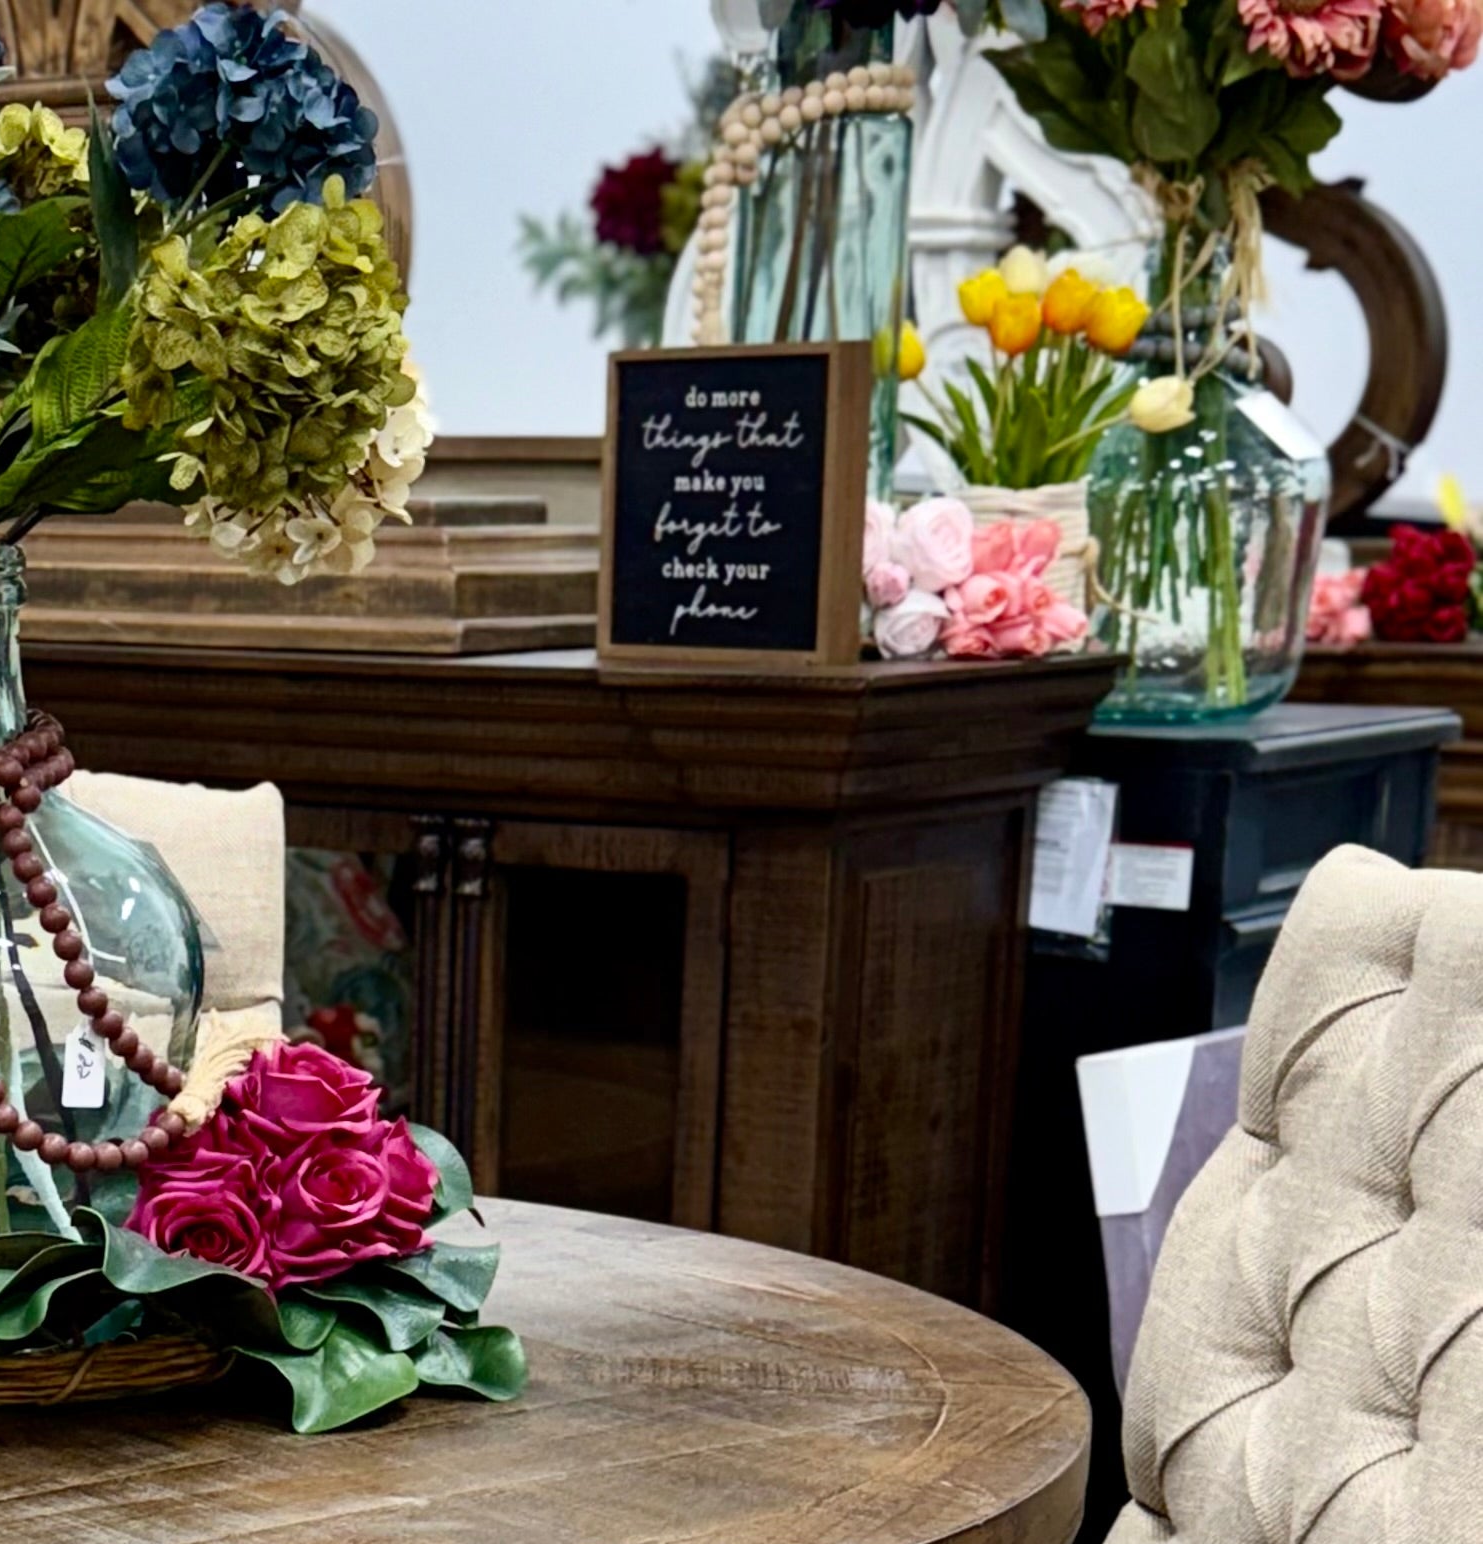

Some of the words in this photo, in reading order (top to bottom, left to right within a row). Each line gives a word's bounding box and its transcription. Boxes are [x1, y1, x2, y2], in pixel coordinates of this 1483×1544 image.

[685, 386, 707, 408] do
[711, 390, 760, 407] more
[641, 414, 732, 468] things
[736, 412, 804, 448] that
[674, 470, 726, 492] make
[729, 475, 765, 498] you
[654, 502, 743, 555] forget
[747, 502, 781, 538] to
[662, 557, 719, 579] check
[723, 562, 770, 586] your
[670, 584, 758, 636] phone
